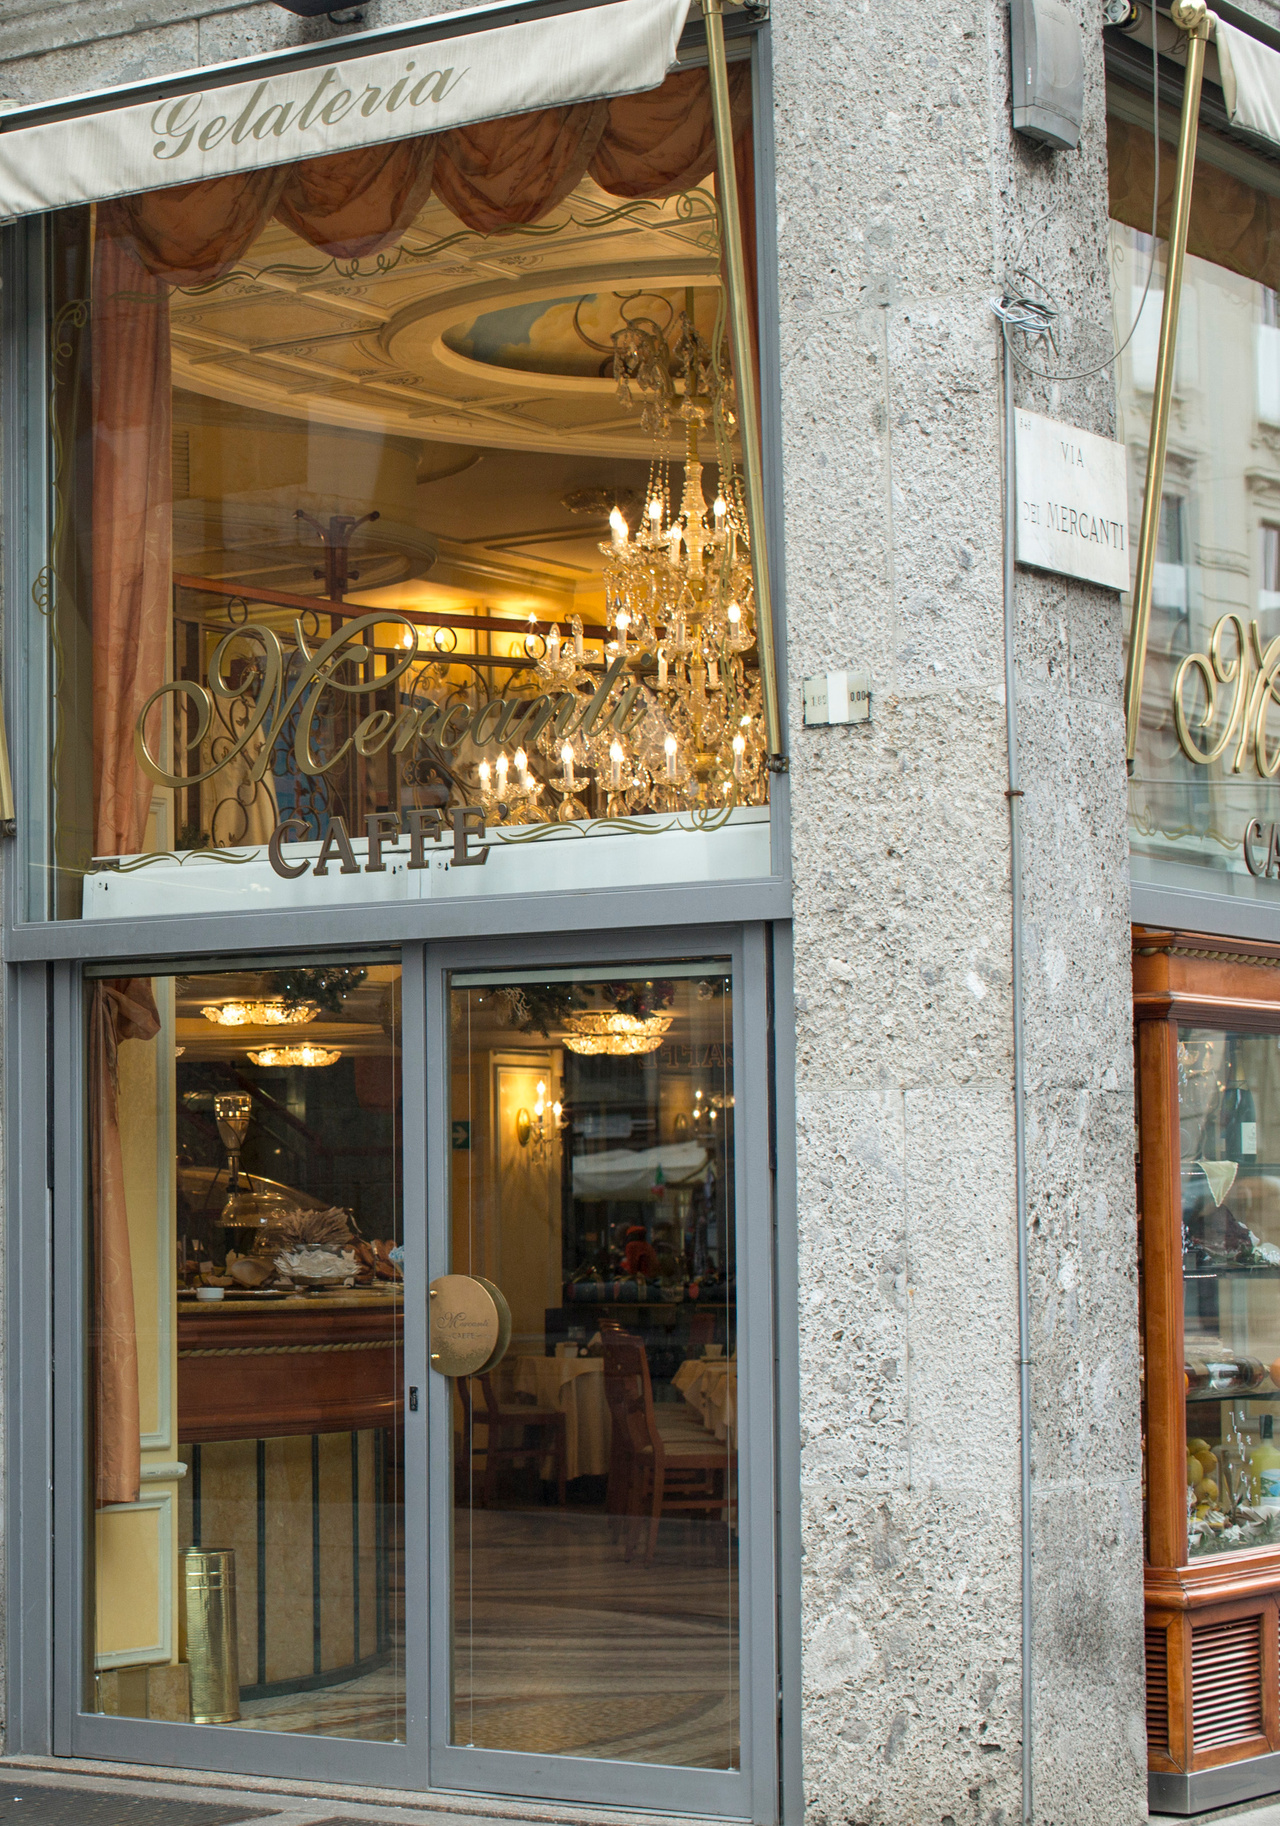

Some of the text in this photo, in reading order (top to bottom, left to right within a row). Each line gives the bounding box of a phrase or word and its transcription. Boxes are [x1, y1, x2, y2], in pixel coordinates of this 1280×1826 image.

[150, 60, 471, 160] Gelateria
[1060, 441, 1084, 468] VIA
[1023, 501, 1125, 551] DEI MERCANTI
[134, 612, 654, 789] Mercanti
[268, 803, 509, 880] CAFFE'
